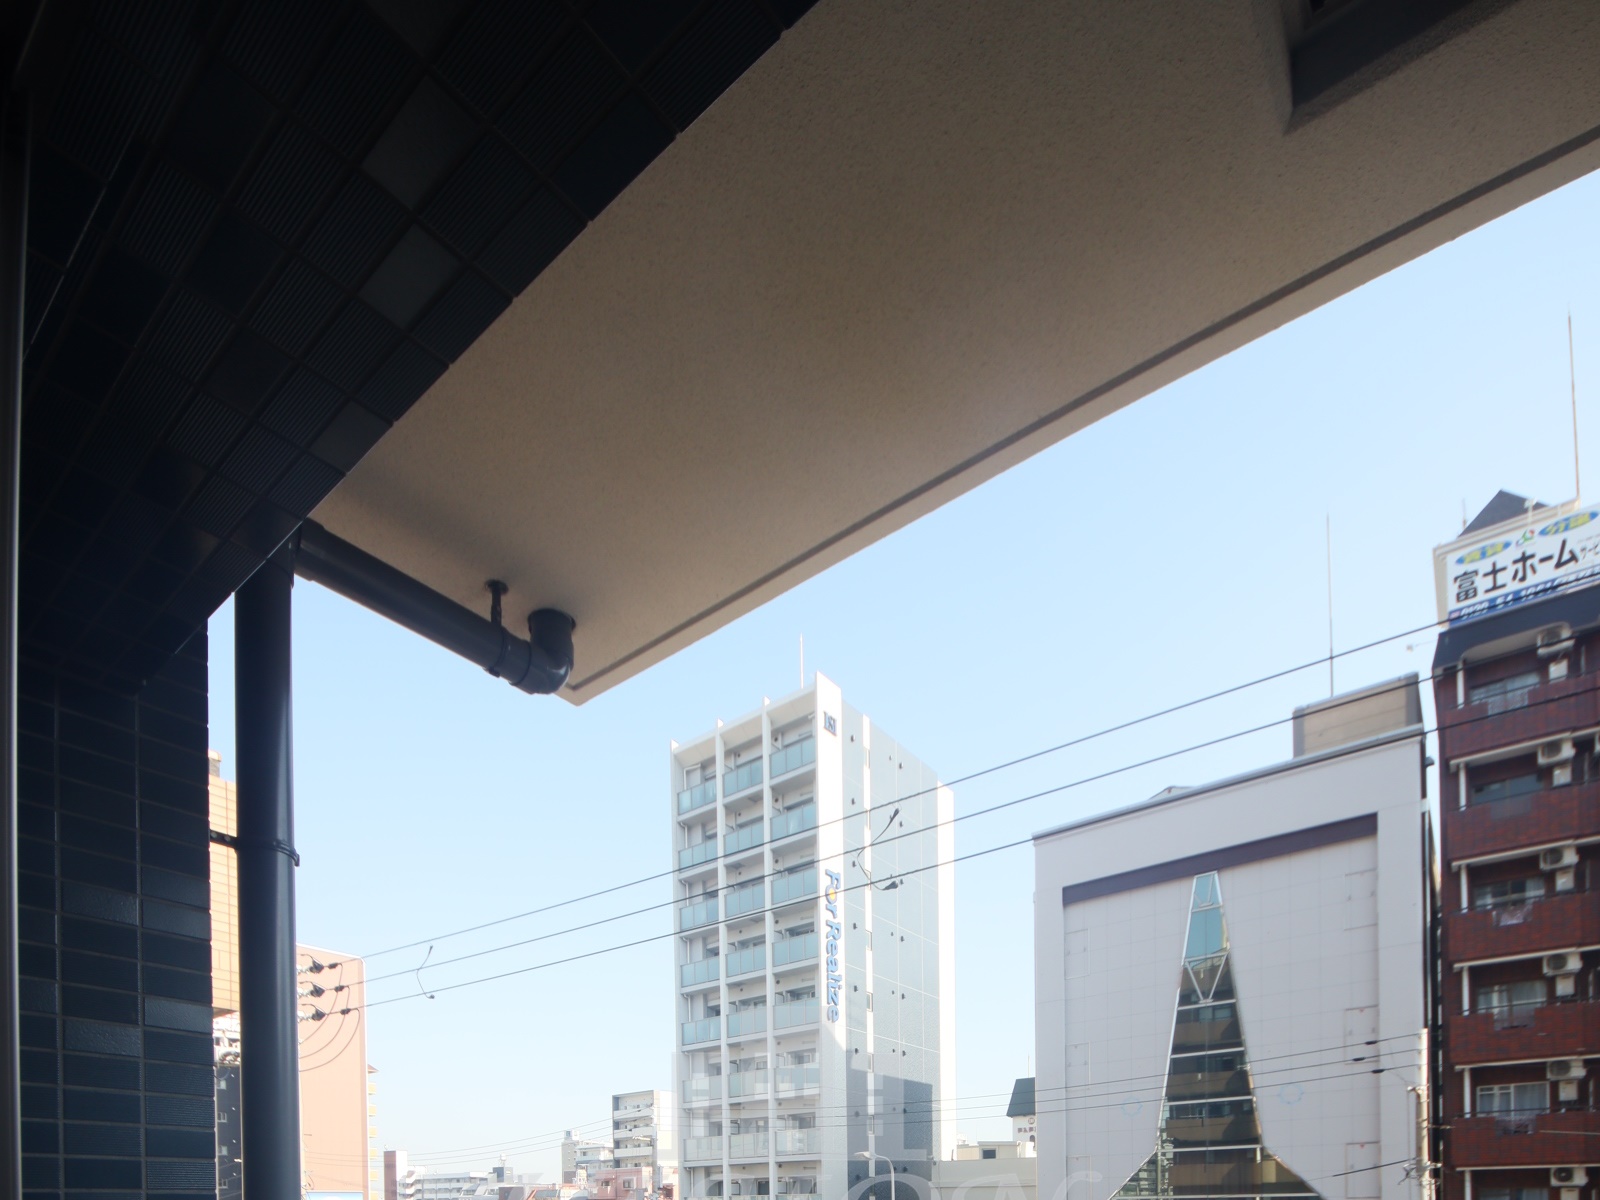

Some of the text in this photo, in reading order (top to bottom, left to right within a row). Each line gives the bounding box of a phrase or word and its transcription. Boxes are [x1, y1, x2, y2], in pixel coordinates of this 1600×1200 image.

[1453, 538, 1579, 603] 富士ホーム
[825, 868, 843, 1023] For Realize
